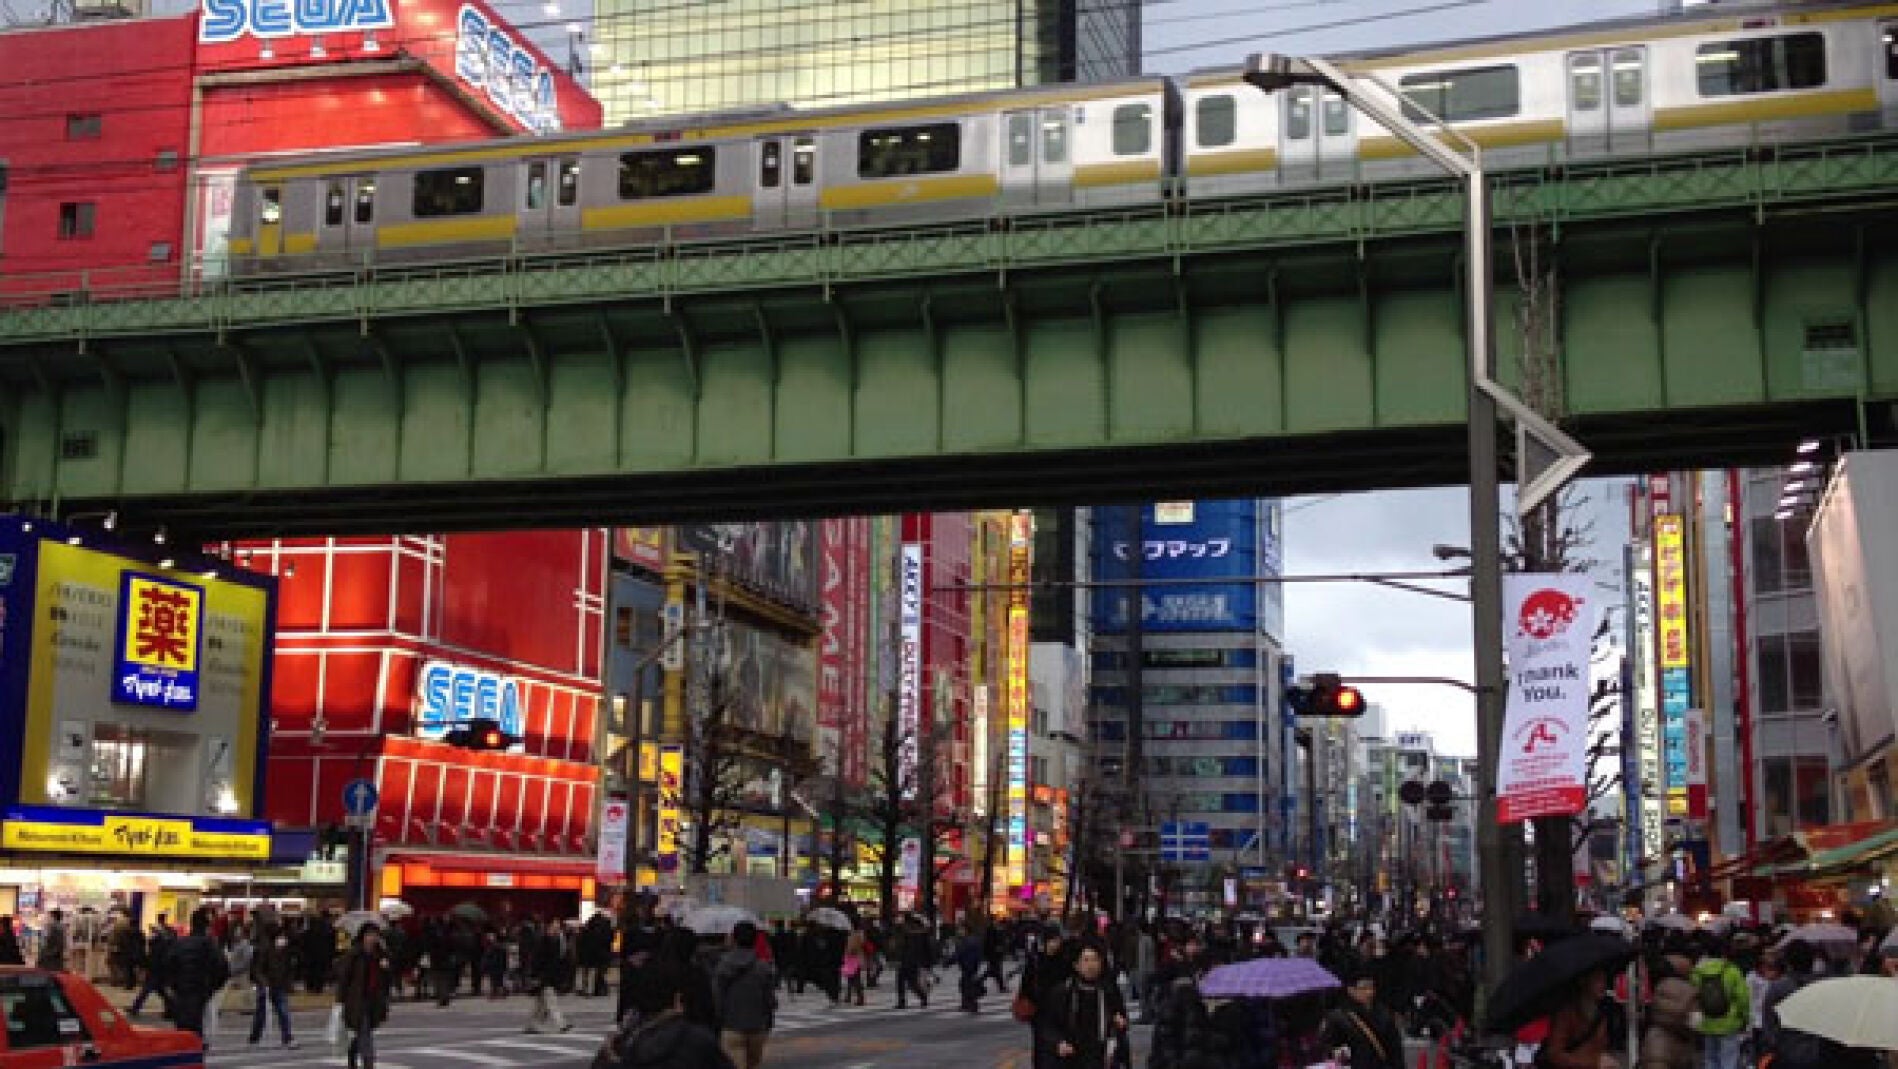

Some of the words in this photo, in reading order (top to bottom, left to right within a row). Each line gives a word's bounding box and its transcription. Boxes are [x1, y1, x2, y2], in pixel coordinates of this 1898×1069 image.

[201, 0, 392, 40] SEGA
[457, 6, 560, 135] SEGA
[136, 585, 192, 664] 薬
[421, 663, 522, 745] SEGA
[1517, 661, 1580, 687] Thank
